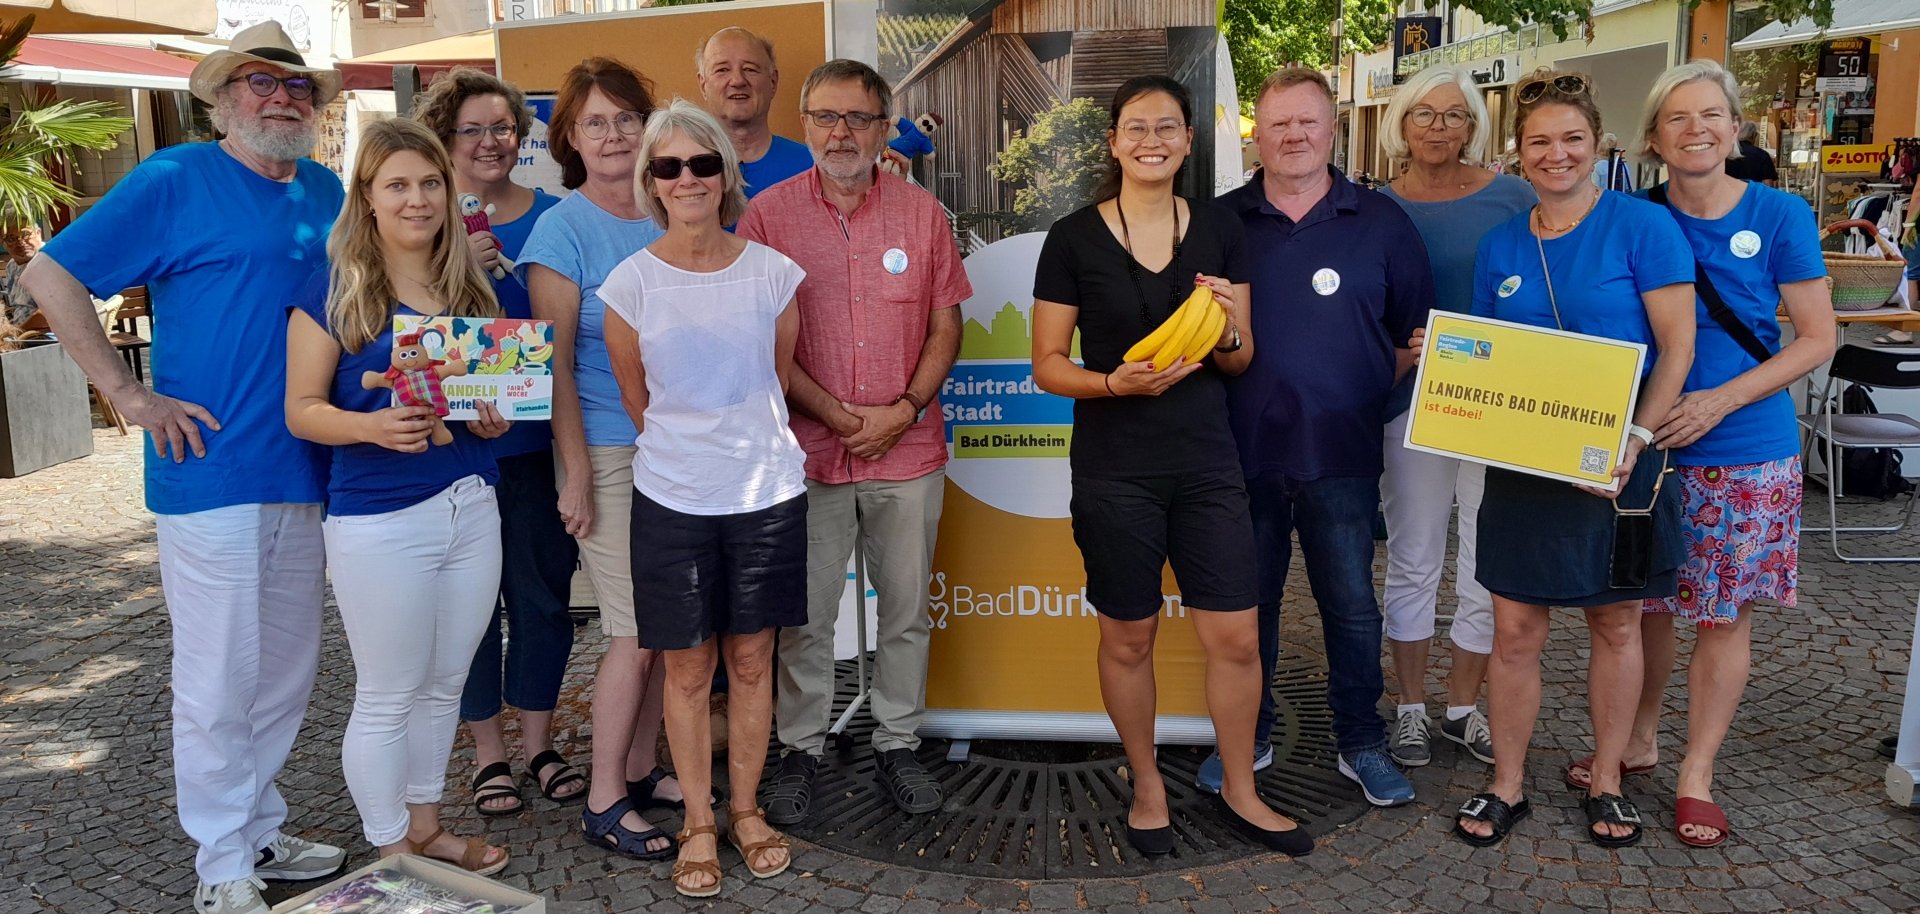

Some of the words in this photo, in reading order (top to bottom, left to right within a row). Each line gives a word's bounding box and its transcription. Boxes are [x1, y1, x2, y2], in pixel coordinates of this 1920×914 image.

[1838, 55, 1861, 76] 50
[942, 401, 1003, 421] Stadt
[1424, 400, 1440, 413] ist
[1442, 404, 1483, 421] dabei!
[1428, 380, 1505, 407] LANDKREIS
[1509, 395, 1536, 413] BAD
[1541, 399, 1617, 429] DÜRKHEIM
[961, 435, 989, 448] Bad
[992, 434, 1066, 447] Dürkheim
